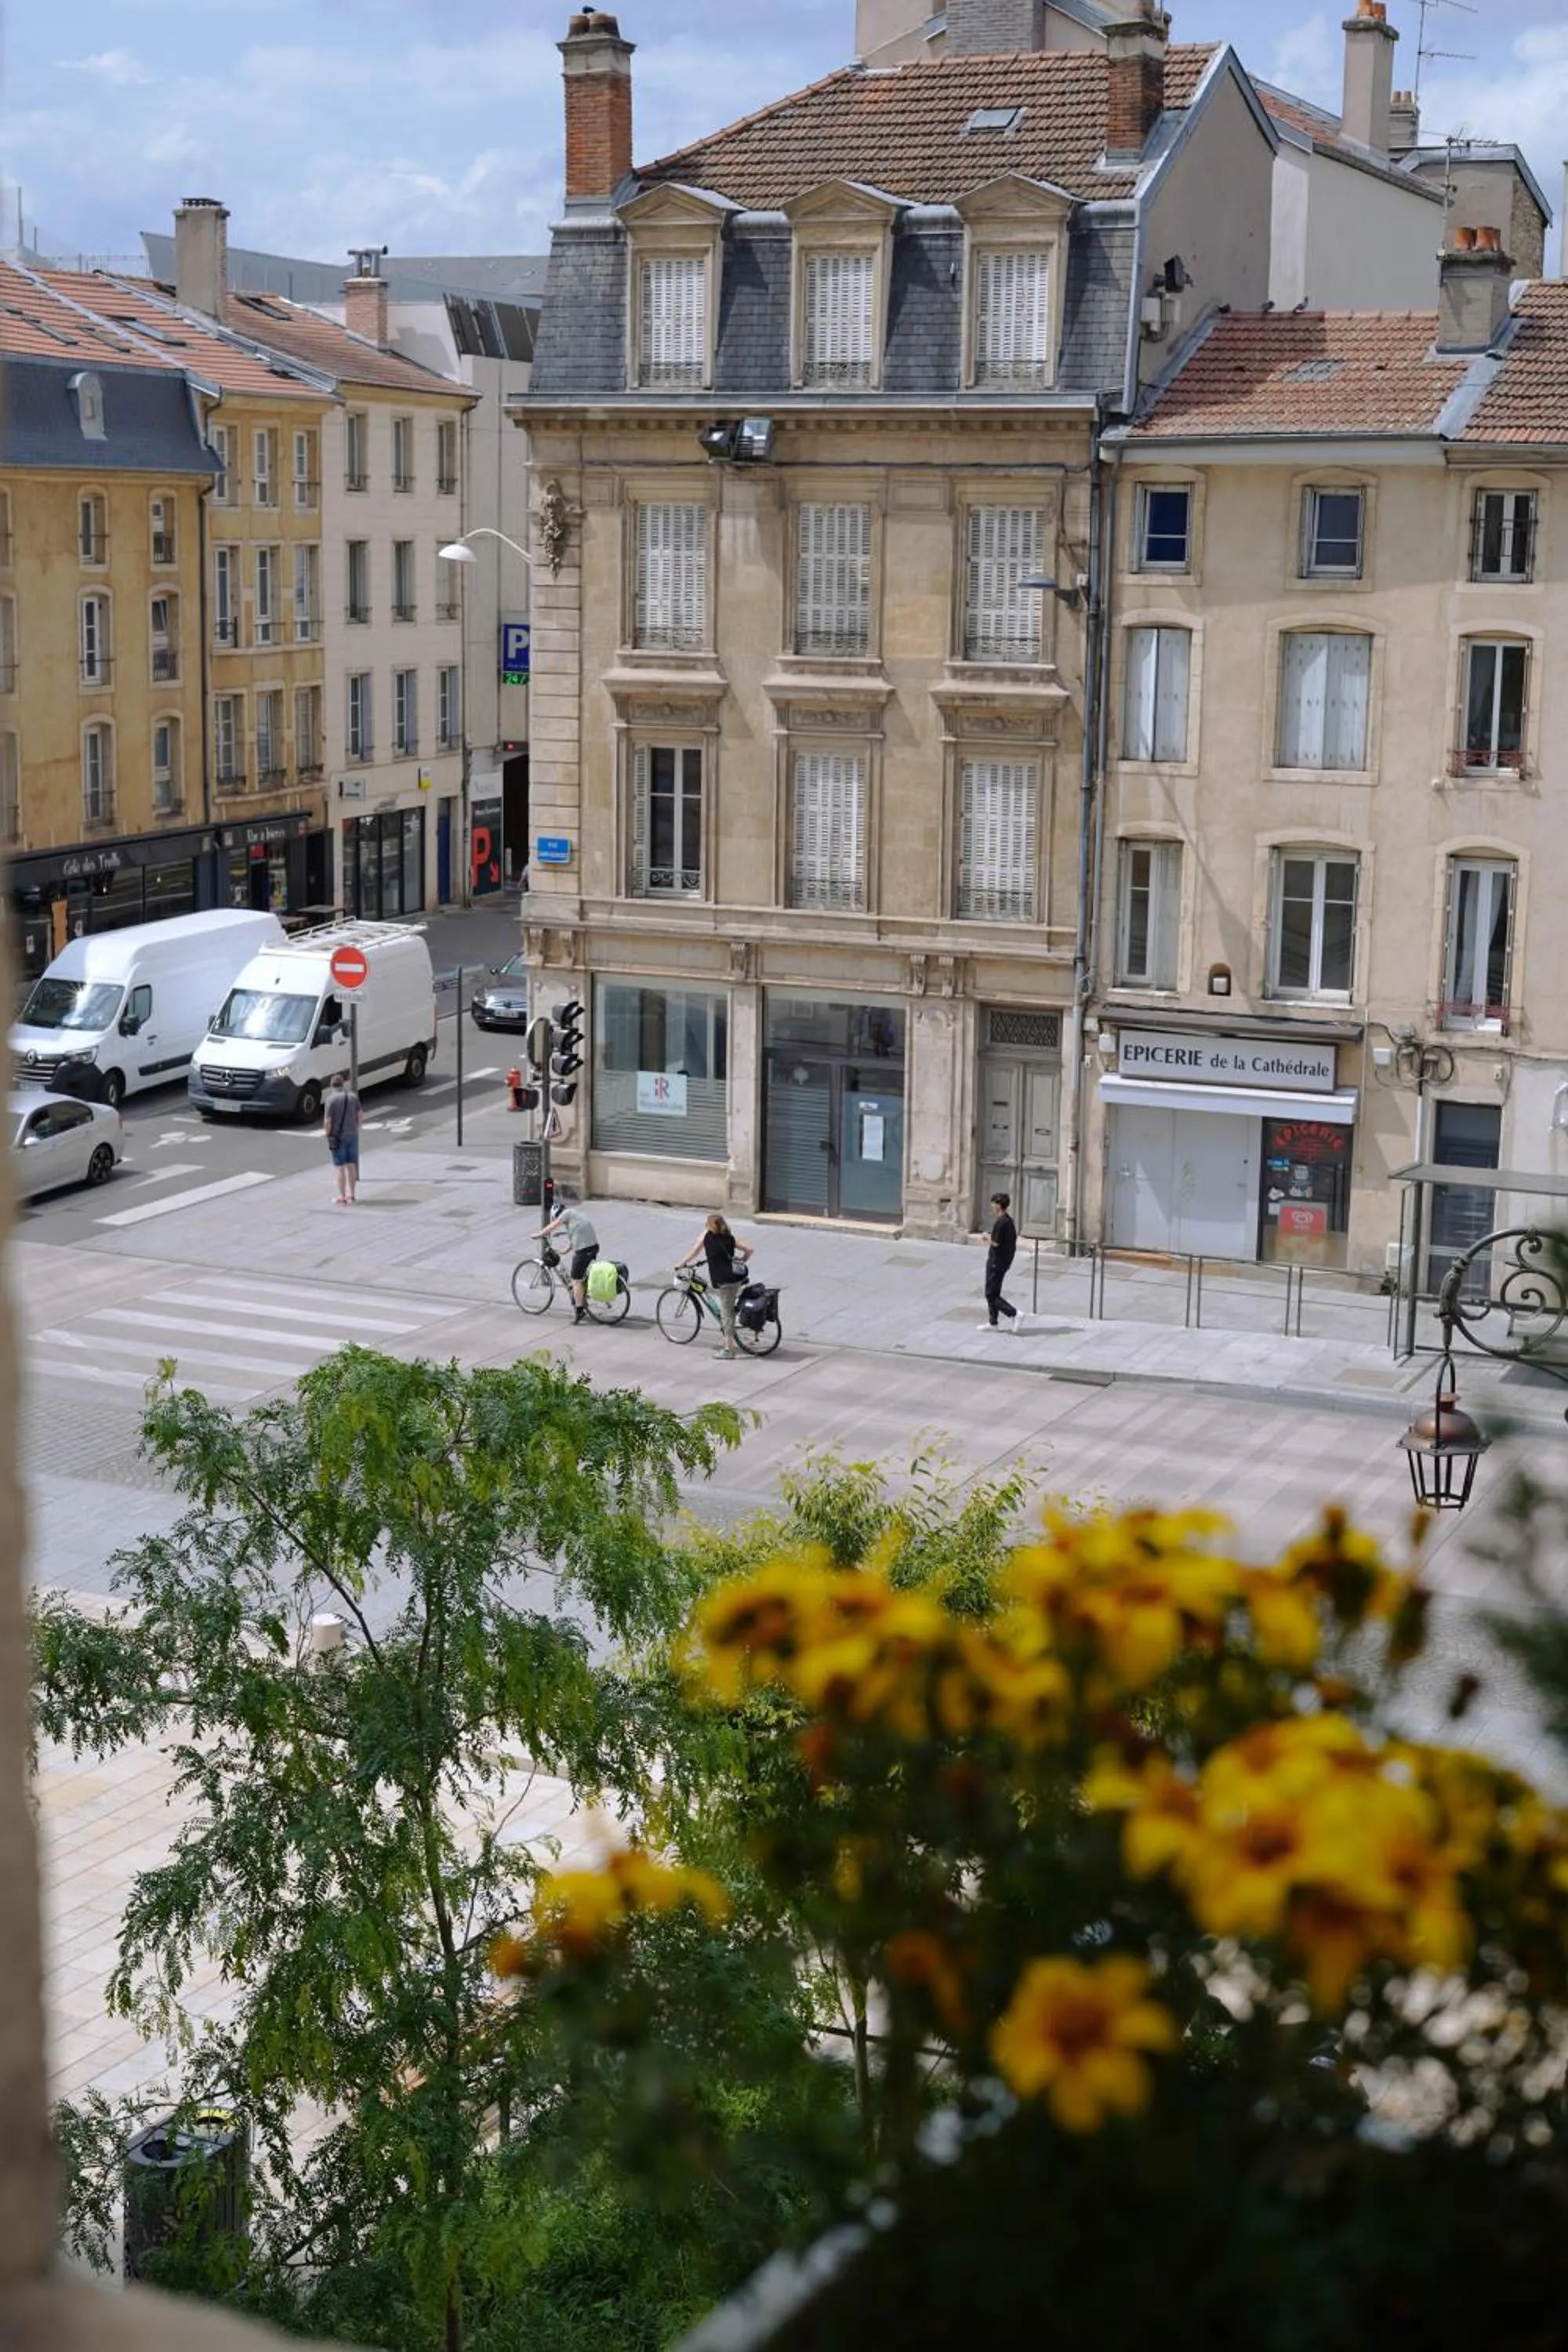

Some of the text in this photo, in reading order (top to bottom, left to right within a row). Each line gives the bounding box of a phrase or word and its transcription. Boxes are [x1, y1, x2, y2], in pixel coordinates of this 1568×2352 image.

[506, 627, 529, 659] P
[471, 827, 492, 887] P
[1123, 1044, 1330, 1077] EPICERIE de la Cathédrale
